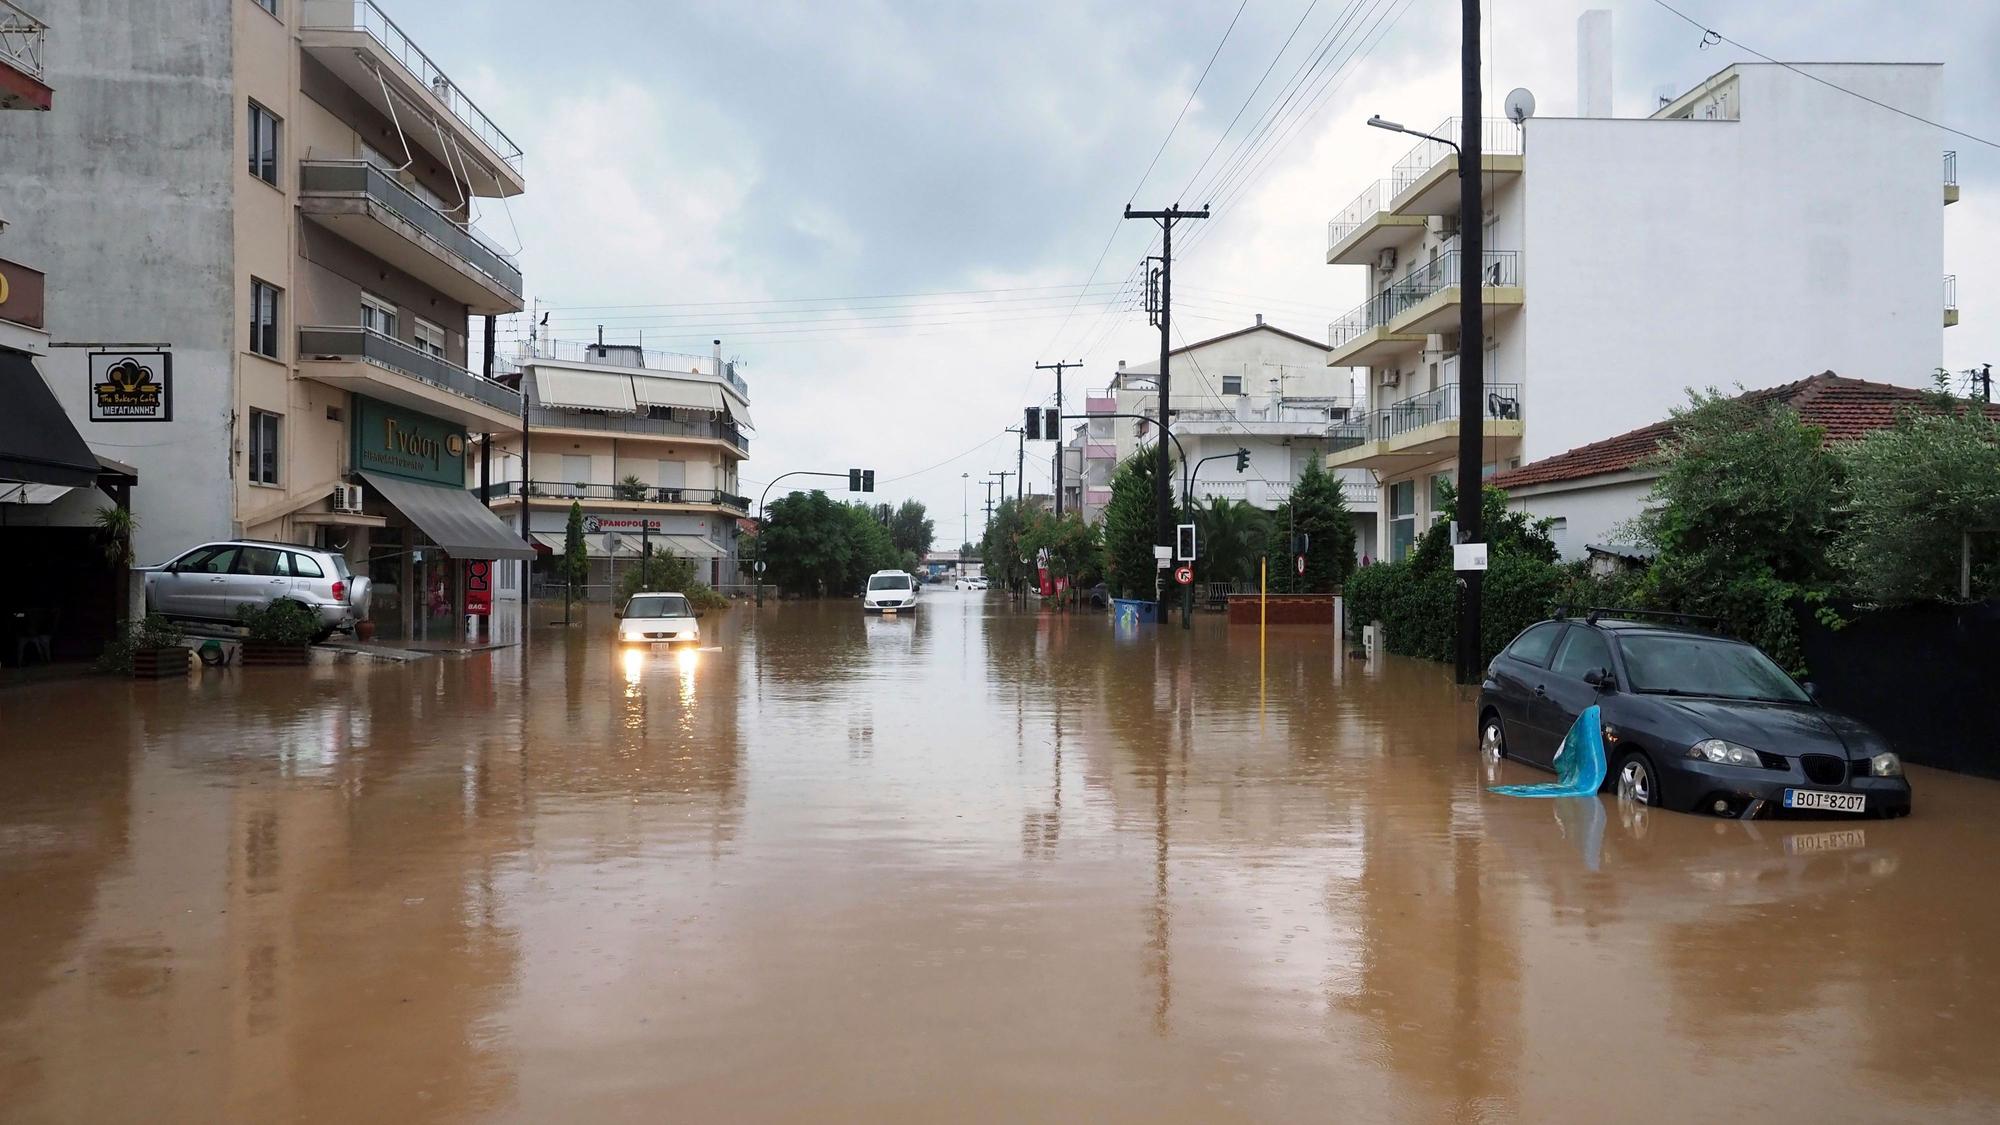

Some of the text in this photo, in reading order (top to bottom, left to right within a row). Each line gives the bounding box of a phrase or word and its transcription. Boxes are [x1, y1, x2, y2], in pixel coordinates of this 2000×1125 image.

[101, 394, 112, 403] The
[114, 393, 138, 405] Bakery
[104, 405, 155, 415] ΜΕΓΑΓΙΑΝΝΗΣ
[384, 417, 441, 472] Γνώση
